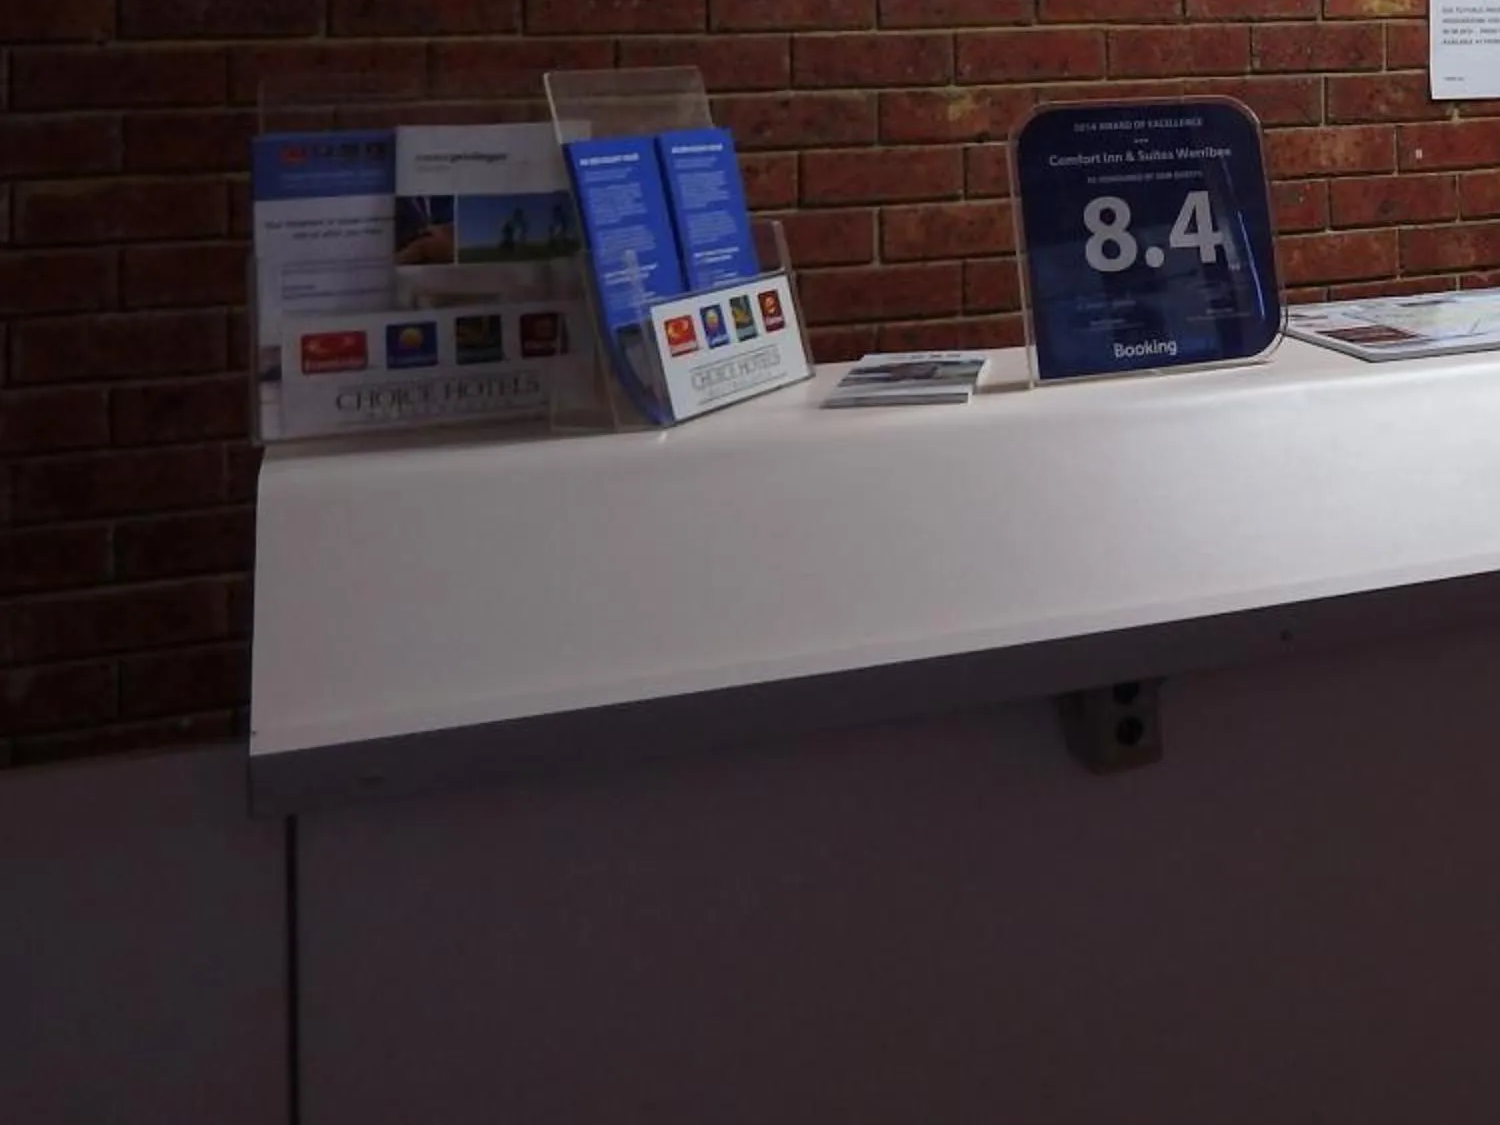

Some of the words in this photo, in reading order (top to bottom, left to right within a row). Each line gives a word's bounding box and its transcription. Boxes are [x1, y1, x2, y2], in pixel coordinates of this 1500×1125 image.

[1049, 153, 1101, 167] Comfort
[1103, 151, 1123, 163] Inn
[1125, 150, 1136, 162] &
[1138, 149, 1175, 162] Suites
[1176, 146, 1232, 159] Werribee
[1083, 190, 1224, 273] 8.4
[1112, 339, 1178, 359] Booking
[335, 381, 432, 413] CHOICE
[443, 375, 541, 401] HOTELS
